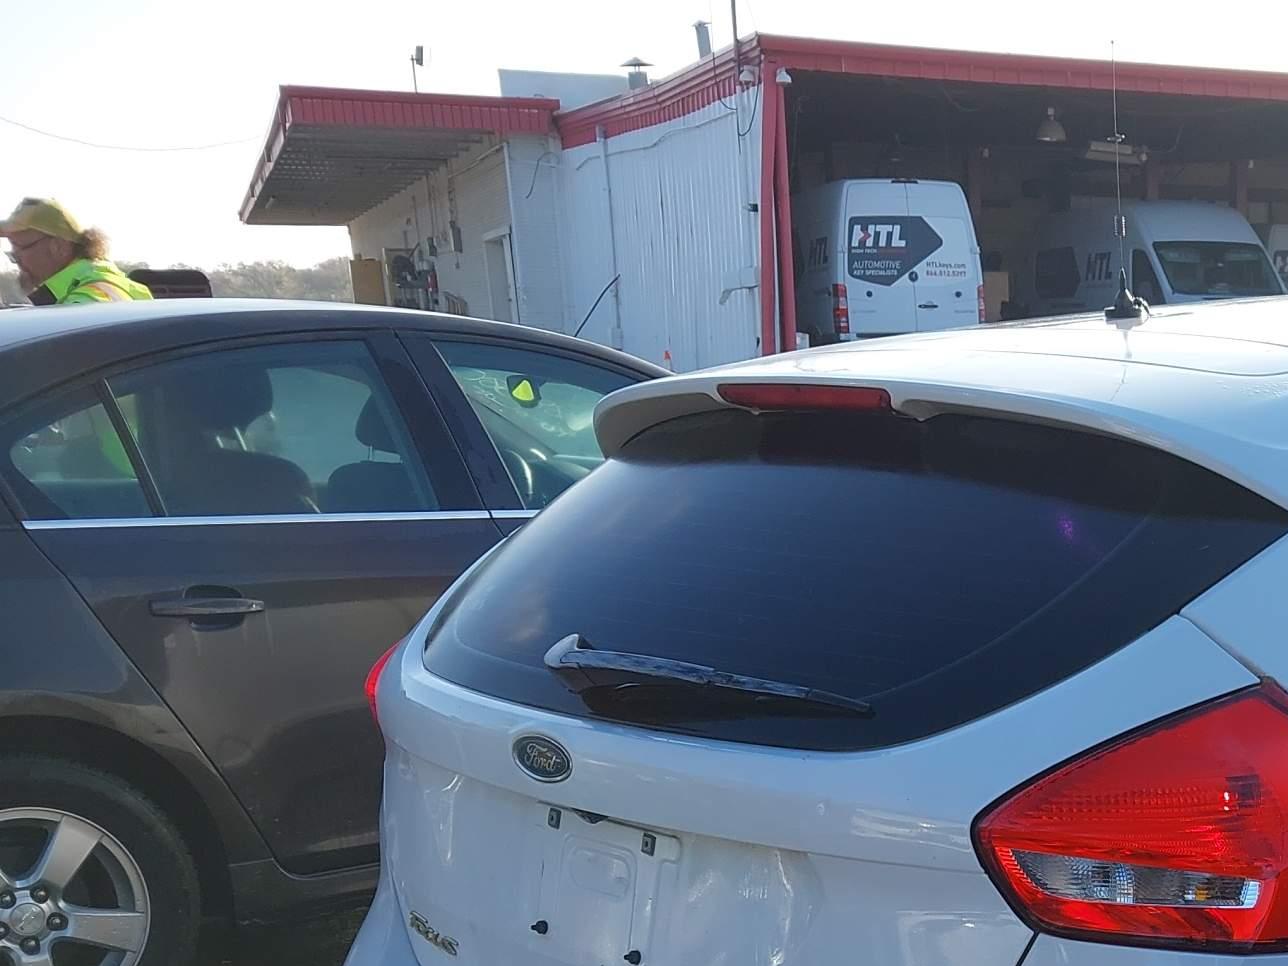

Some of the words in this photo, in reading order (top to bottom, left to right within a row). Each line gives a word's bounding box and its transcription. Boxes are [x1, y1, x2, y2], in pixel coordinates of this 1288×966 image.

[851, 224, 906, 247] HTL
[852, 260, 903, 269] AUTOMOTIVE
[525, 743, 561, 771] Ford
